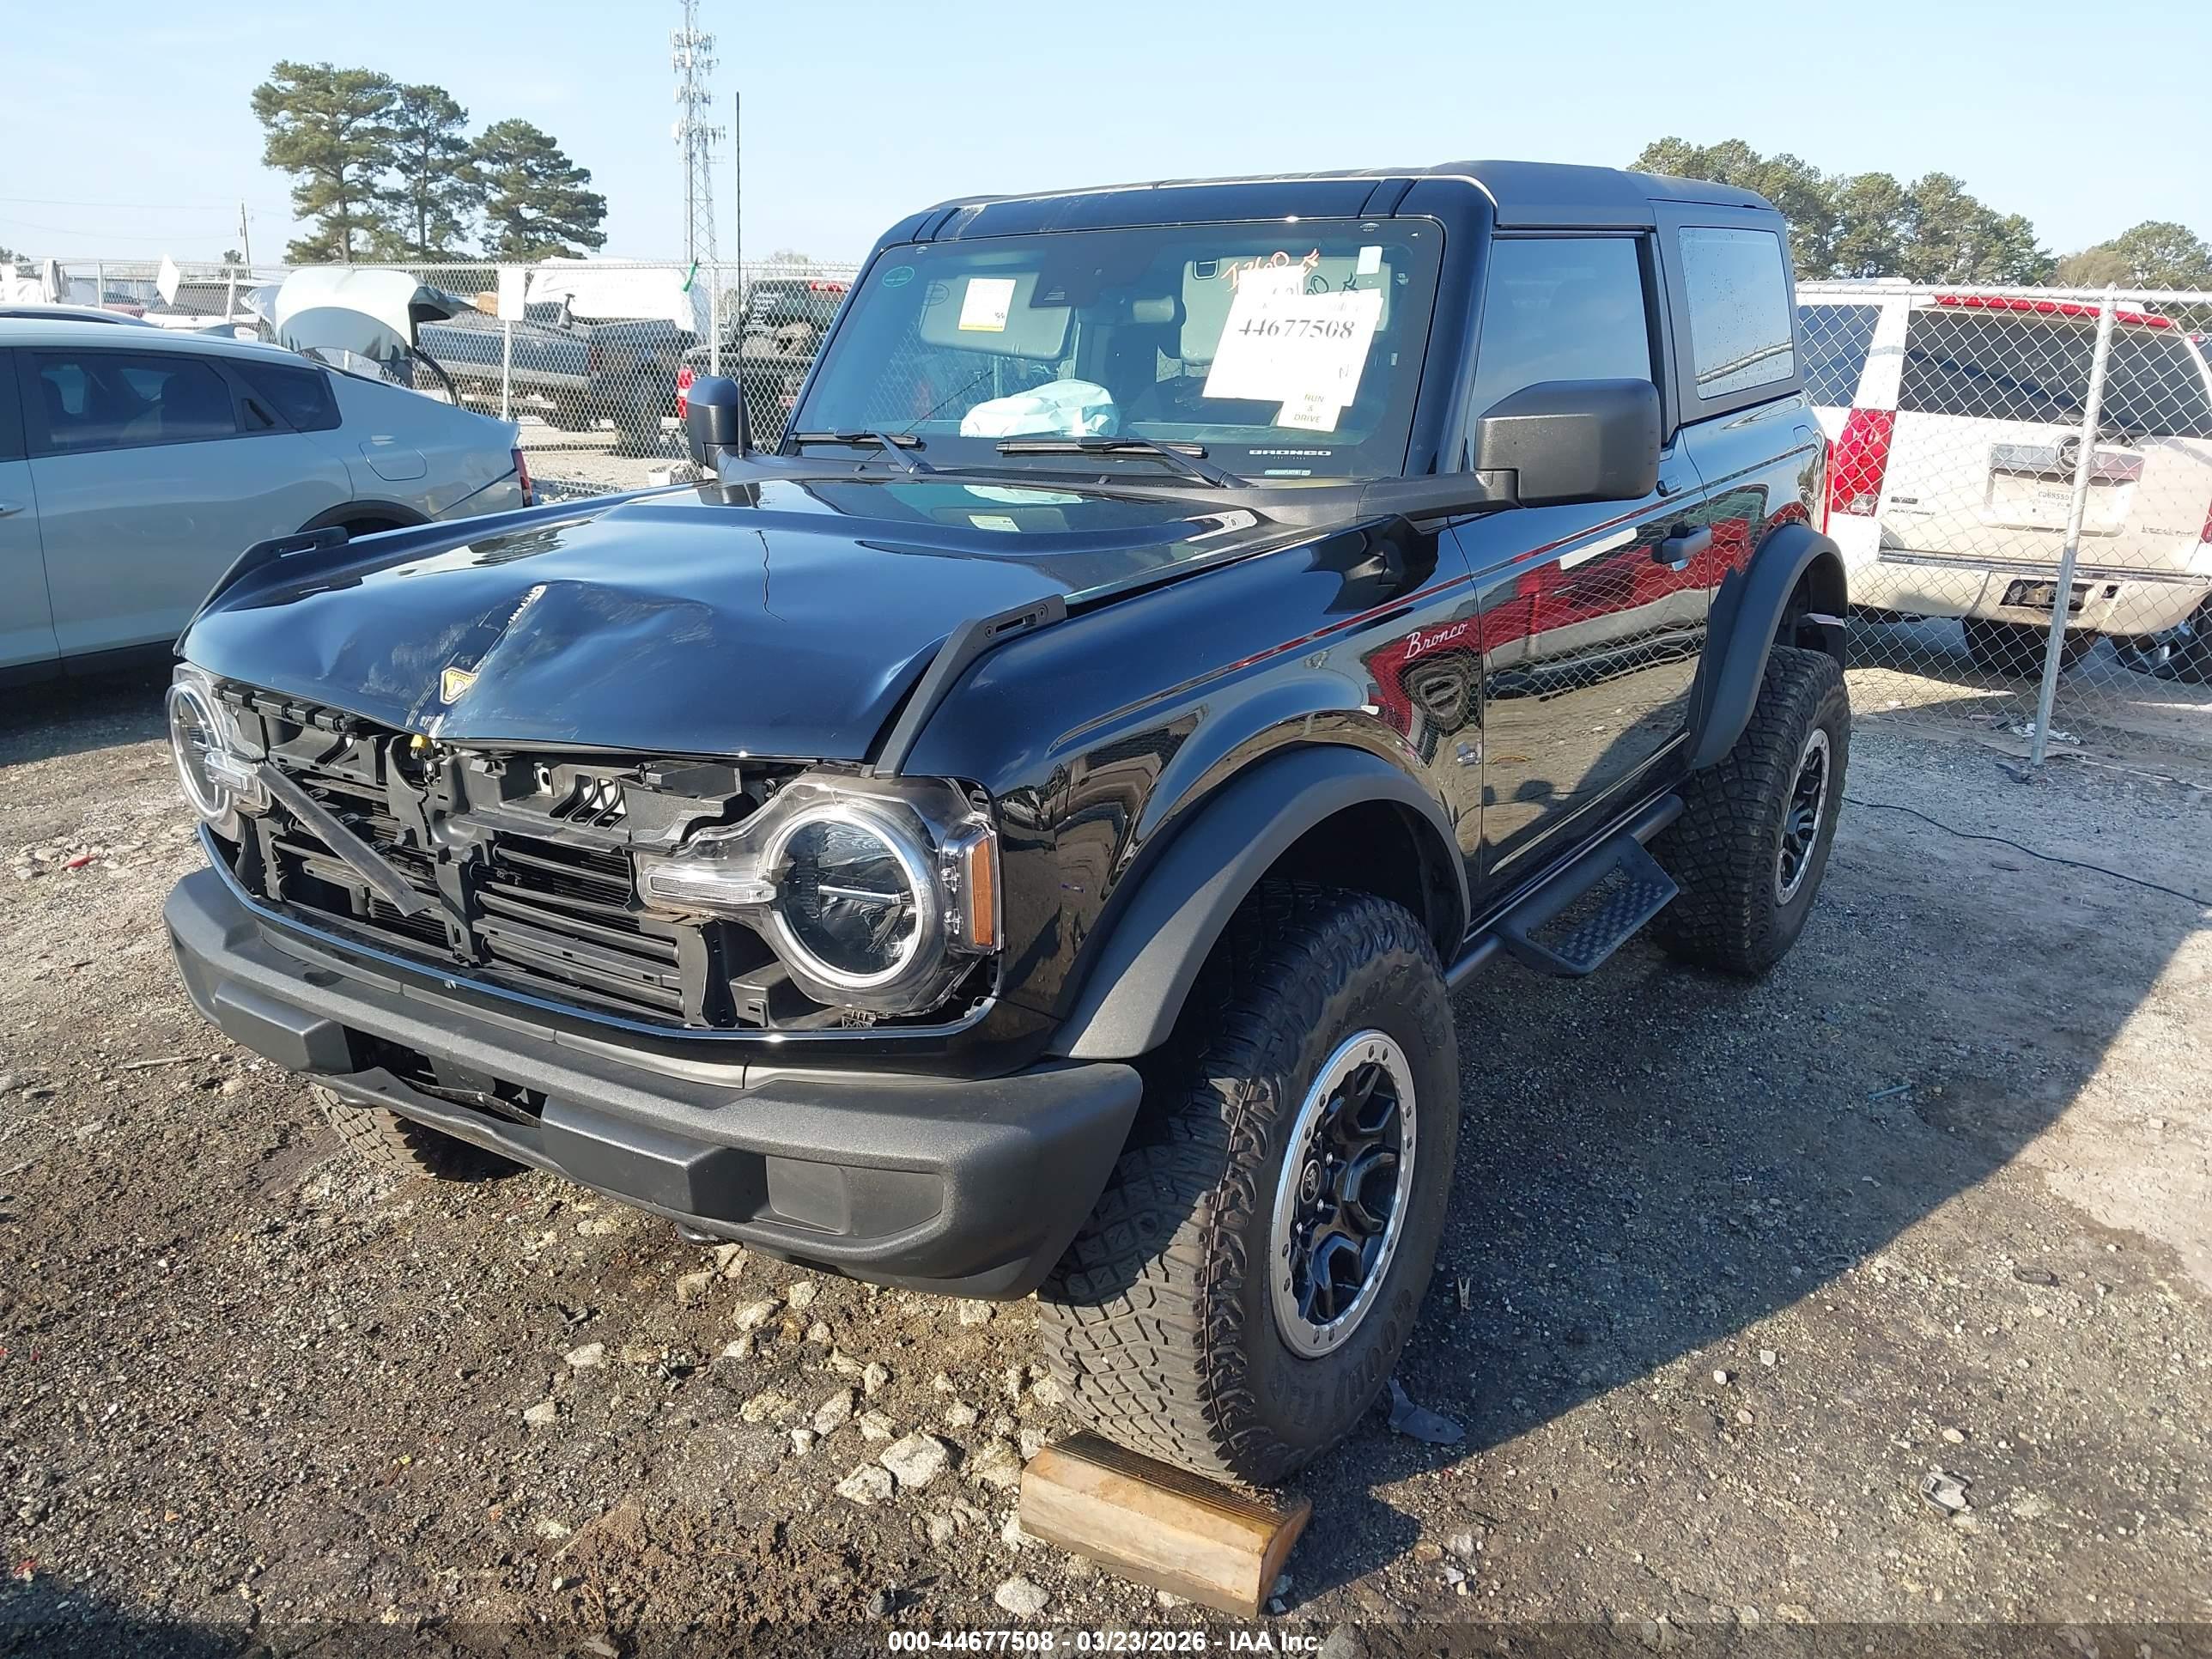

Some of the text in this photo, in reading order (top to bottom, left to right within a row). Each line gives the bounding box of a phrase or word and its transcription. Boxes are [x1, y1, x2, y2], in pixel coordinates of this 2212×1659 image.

[1239, 318, 1354, 339] 44677508
[1304, 393, 1325, 403] RUN
[1293, 414, 1322, 423] DRIVE
[1403, 623, 1468, 659] Bronco
